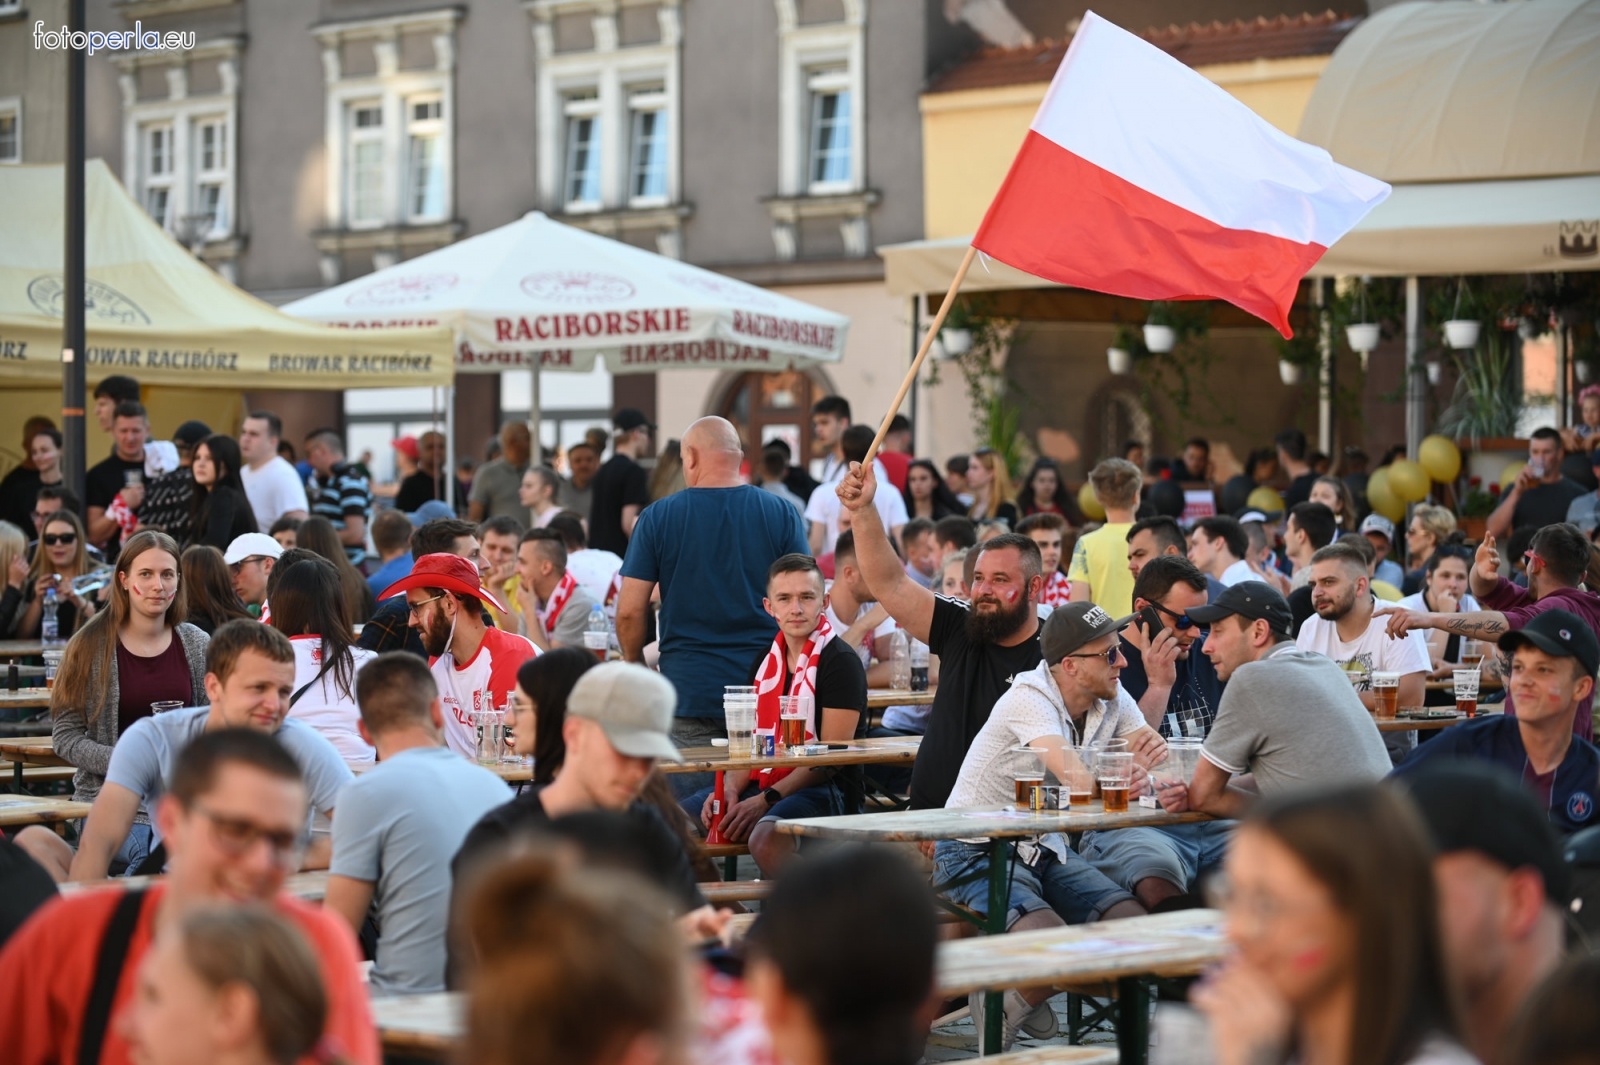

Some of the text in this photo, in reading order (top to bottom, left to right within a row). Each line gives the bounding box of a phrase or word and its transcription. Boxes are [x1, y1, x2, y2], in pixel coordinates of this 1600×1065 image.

[495, 307, 690, 342] RACIBORSKIE
[731, 309, 836, 351] RACIBORSKIE
[86, 346, 240, 371] OWAR RACIBÓRZ
[268, 353, 343, 373] BROWAR
